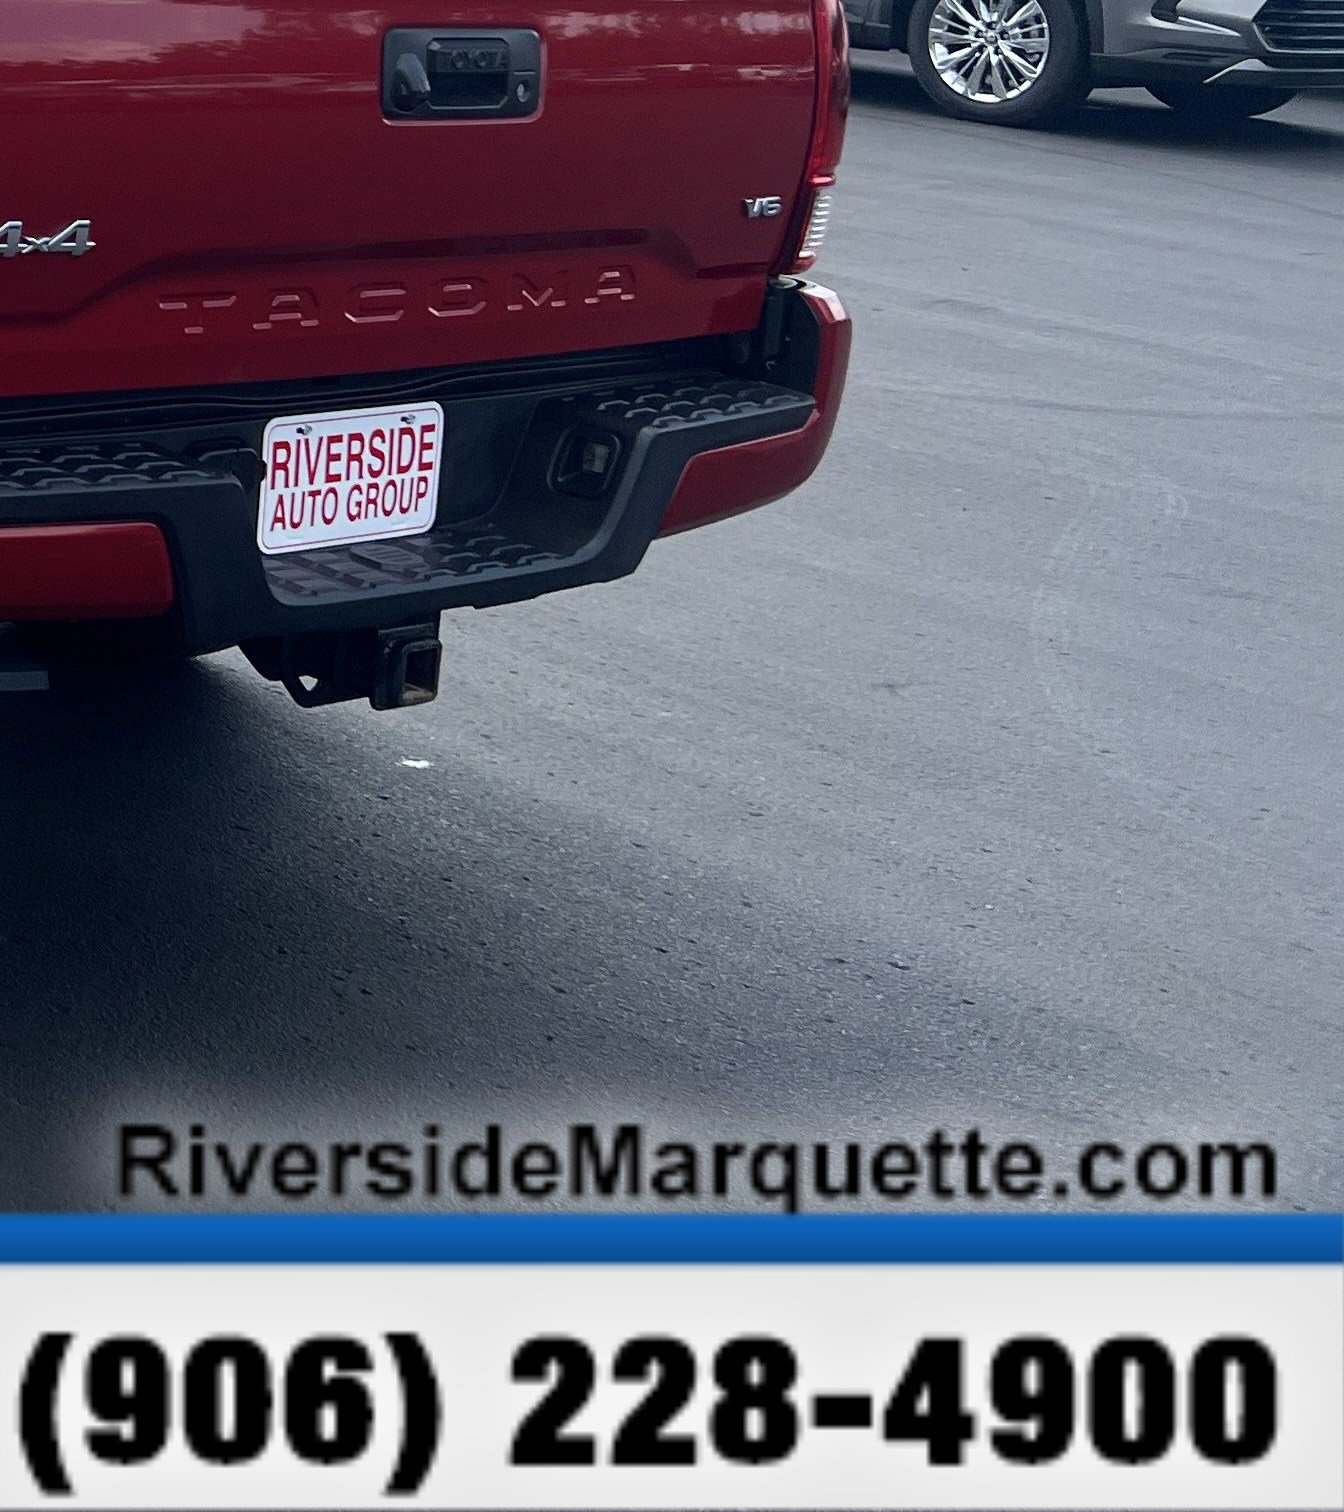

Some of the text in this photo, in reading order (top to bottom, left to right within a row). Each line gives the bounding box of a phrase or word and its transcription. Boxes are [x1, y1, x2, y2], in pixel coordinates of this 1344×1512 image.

[744, 196, 782, 218] V6
[157, 265, 637, 334] TACOMA
[270, 423, 437, 490] RIVERSIDE
[269, 475, 429, 532] AUTO GROUP
